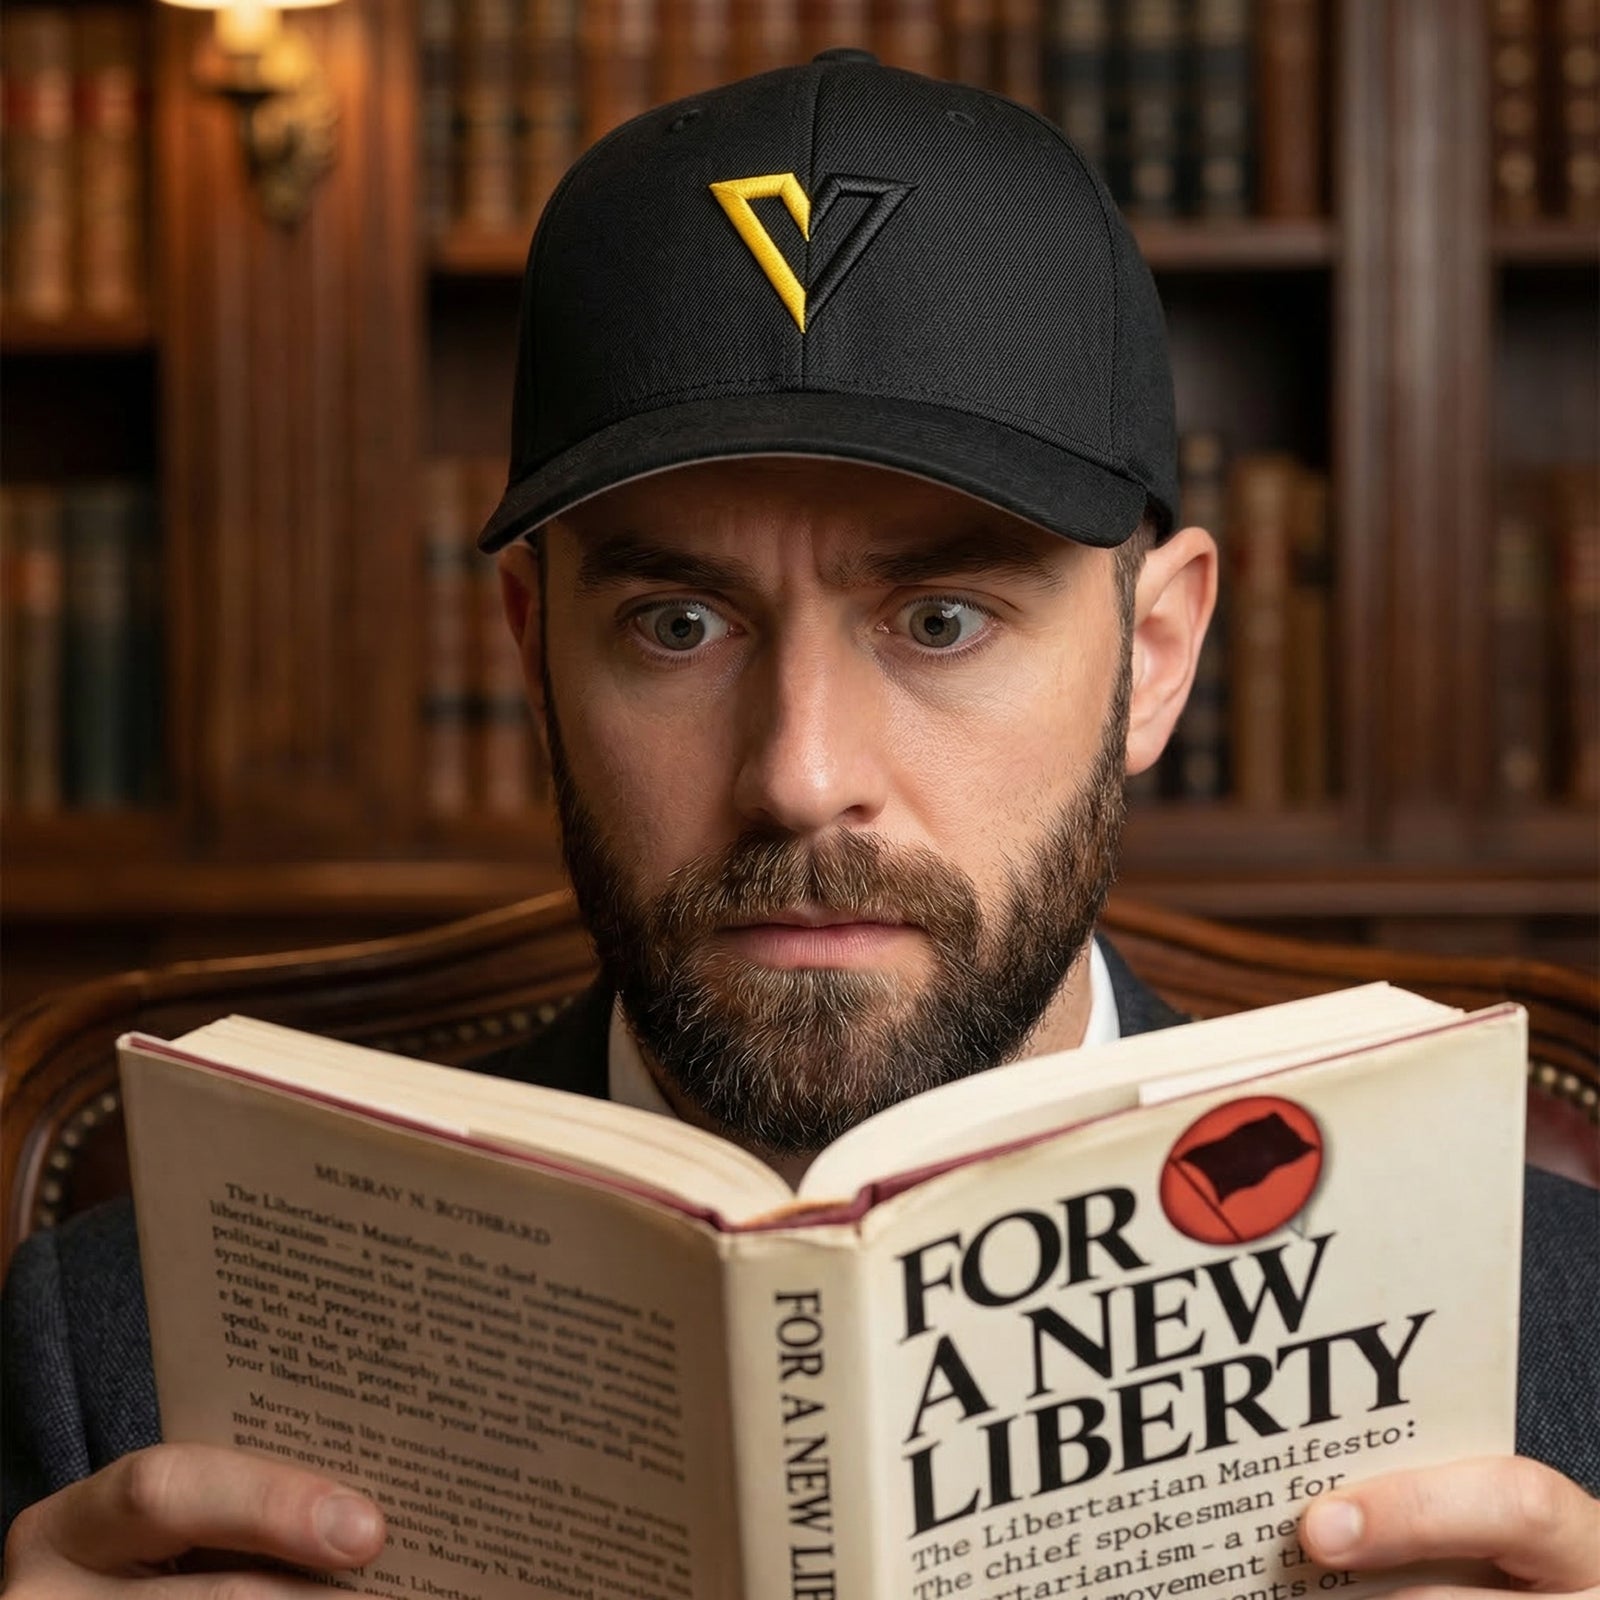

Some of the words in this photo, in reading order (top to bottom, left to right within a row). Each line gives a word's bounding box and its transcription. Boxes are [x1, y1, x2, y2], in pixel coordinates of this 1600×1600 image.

[225, 1183, 257, 1204] The
[212, 1226, 280, 1254] political
[894, 1186, 1152, 1345] FOR
[262, 1298, 288, 1318] left
[298, 1313, 327, 1329] and
[774, 1289, 825, 1382] FOR
[903, 1334, 997, 1444] A
[1021, 1232, 1337, 1399] NEW
[225, 1327, 257, 1350] that
[268, 1345, 299, 1362] will
[307, 1352, 347, 1375] both
[276, 1328, 304, 1343] out
[312, 1335, 338, 1352] the
[226, 1354, 264, 1372] your
[361, 1393, 390, 1408] and
[250, 1392, 310, 1422] Murray
[780, 1393, 826, 1425] A
[903, 1309, 1436, 1539] LIBERTY
[323, 1438, 352, 1454] and
[783, 1432, 834, 1535] NEW
[912, 1537, 971, 1573] The
[983, 1473, 1206, 1549] Libertarian
[1218, 1420, 1416, 1485] Manifesto:
[913, 1572, 973, 1600] The
[985, 1533, 1082, 1580] chief
[1096, 1489, 1274, 1551] spokesman
[1287, 1472, 1345, 1500] for
[1225, 1531, 1242, 1550] a
[1256, 1515, 1301, 1543] ne
[402, 1538, 419, 1550] to
[428, 1542, 488, 1574] Murray
[517, 1567, 593, 1600] Rothbard
